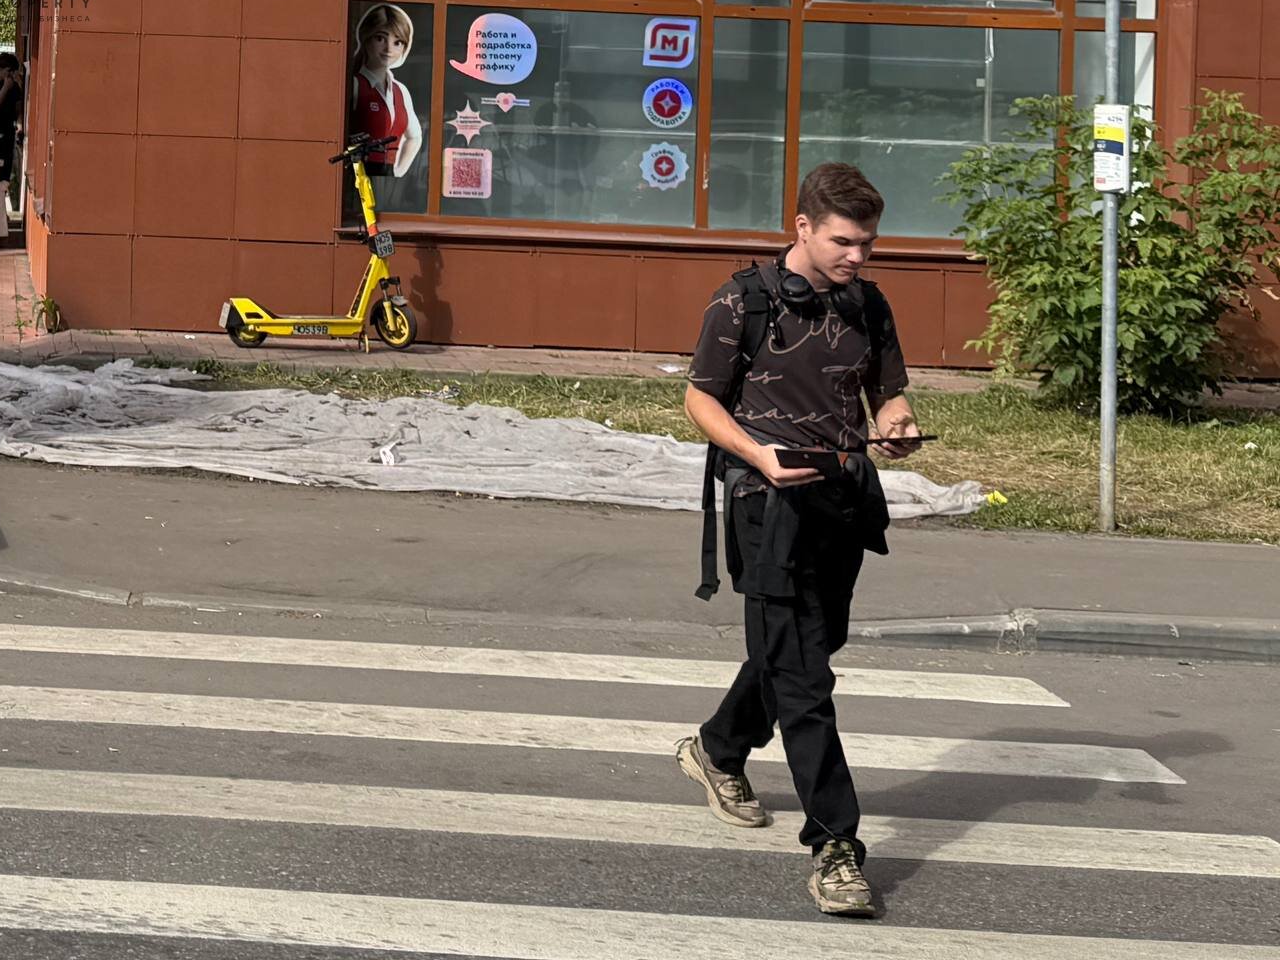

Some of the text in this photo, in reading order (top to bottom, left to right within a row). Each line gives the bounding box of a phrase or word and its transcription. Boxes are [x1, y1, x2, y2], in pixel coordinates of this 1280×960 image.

[475, 30, 509, 39] Работа
[475, 41, 532, 51] подработка
[489, 53, 522, 61] твоему
[475, 63, 516, 73] графику
